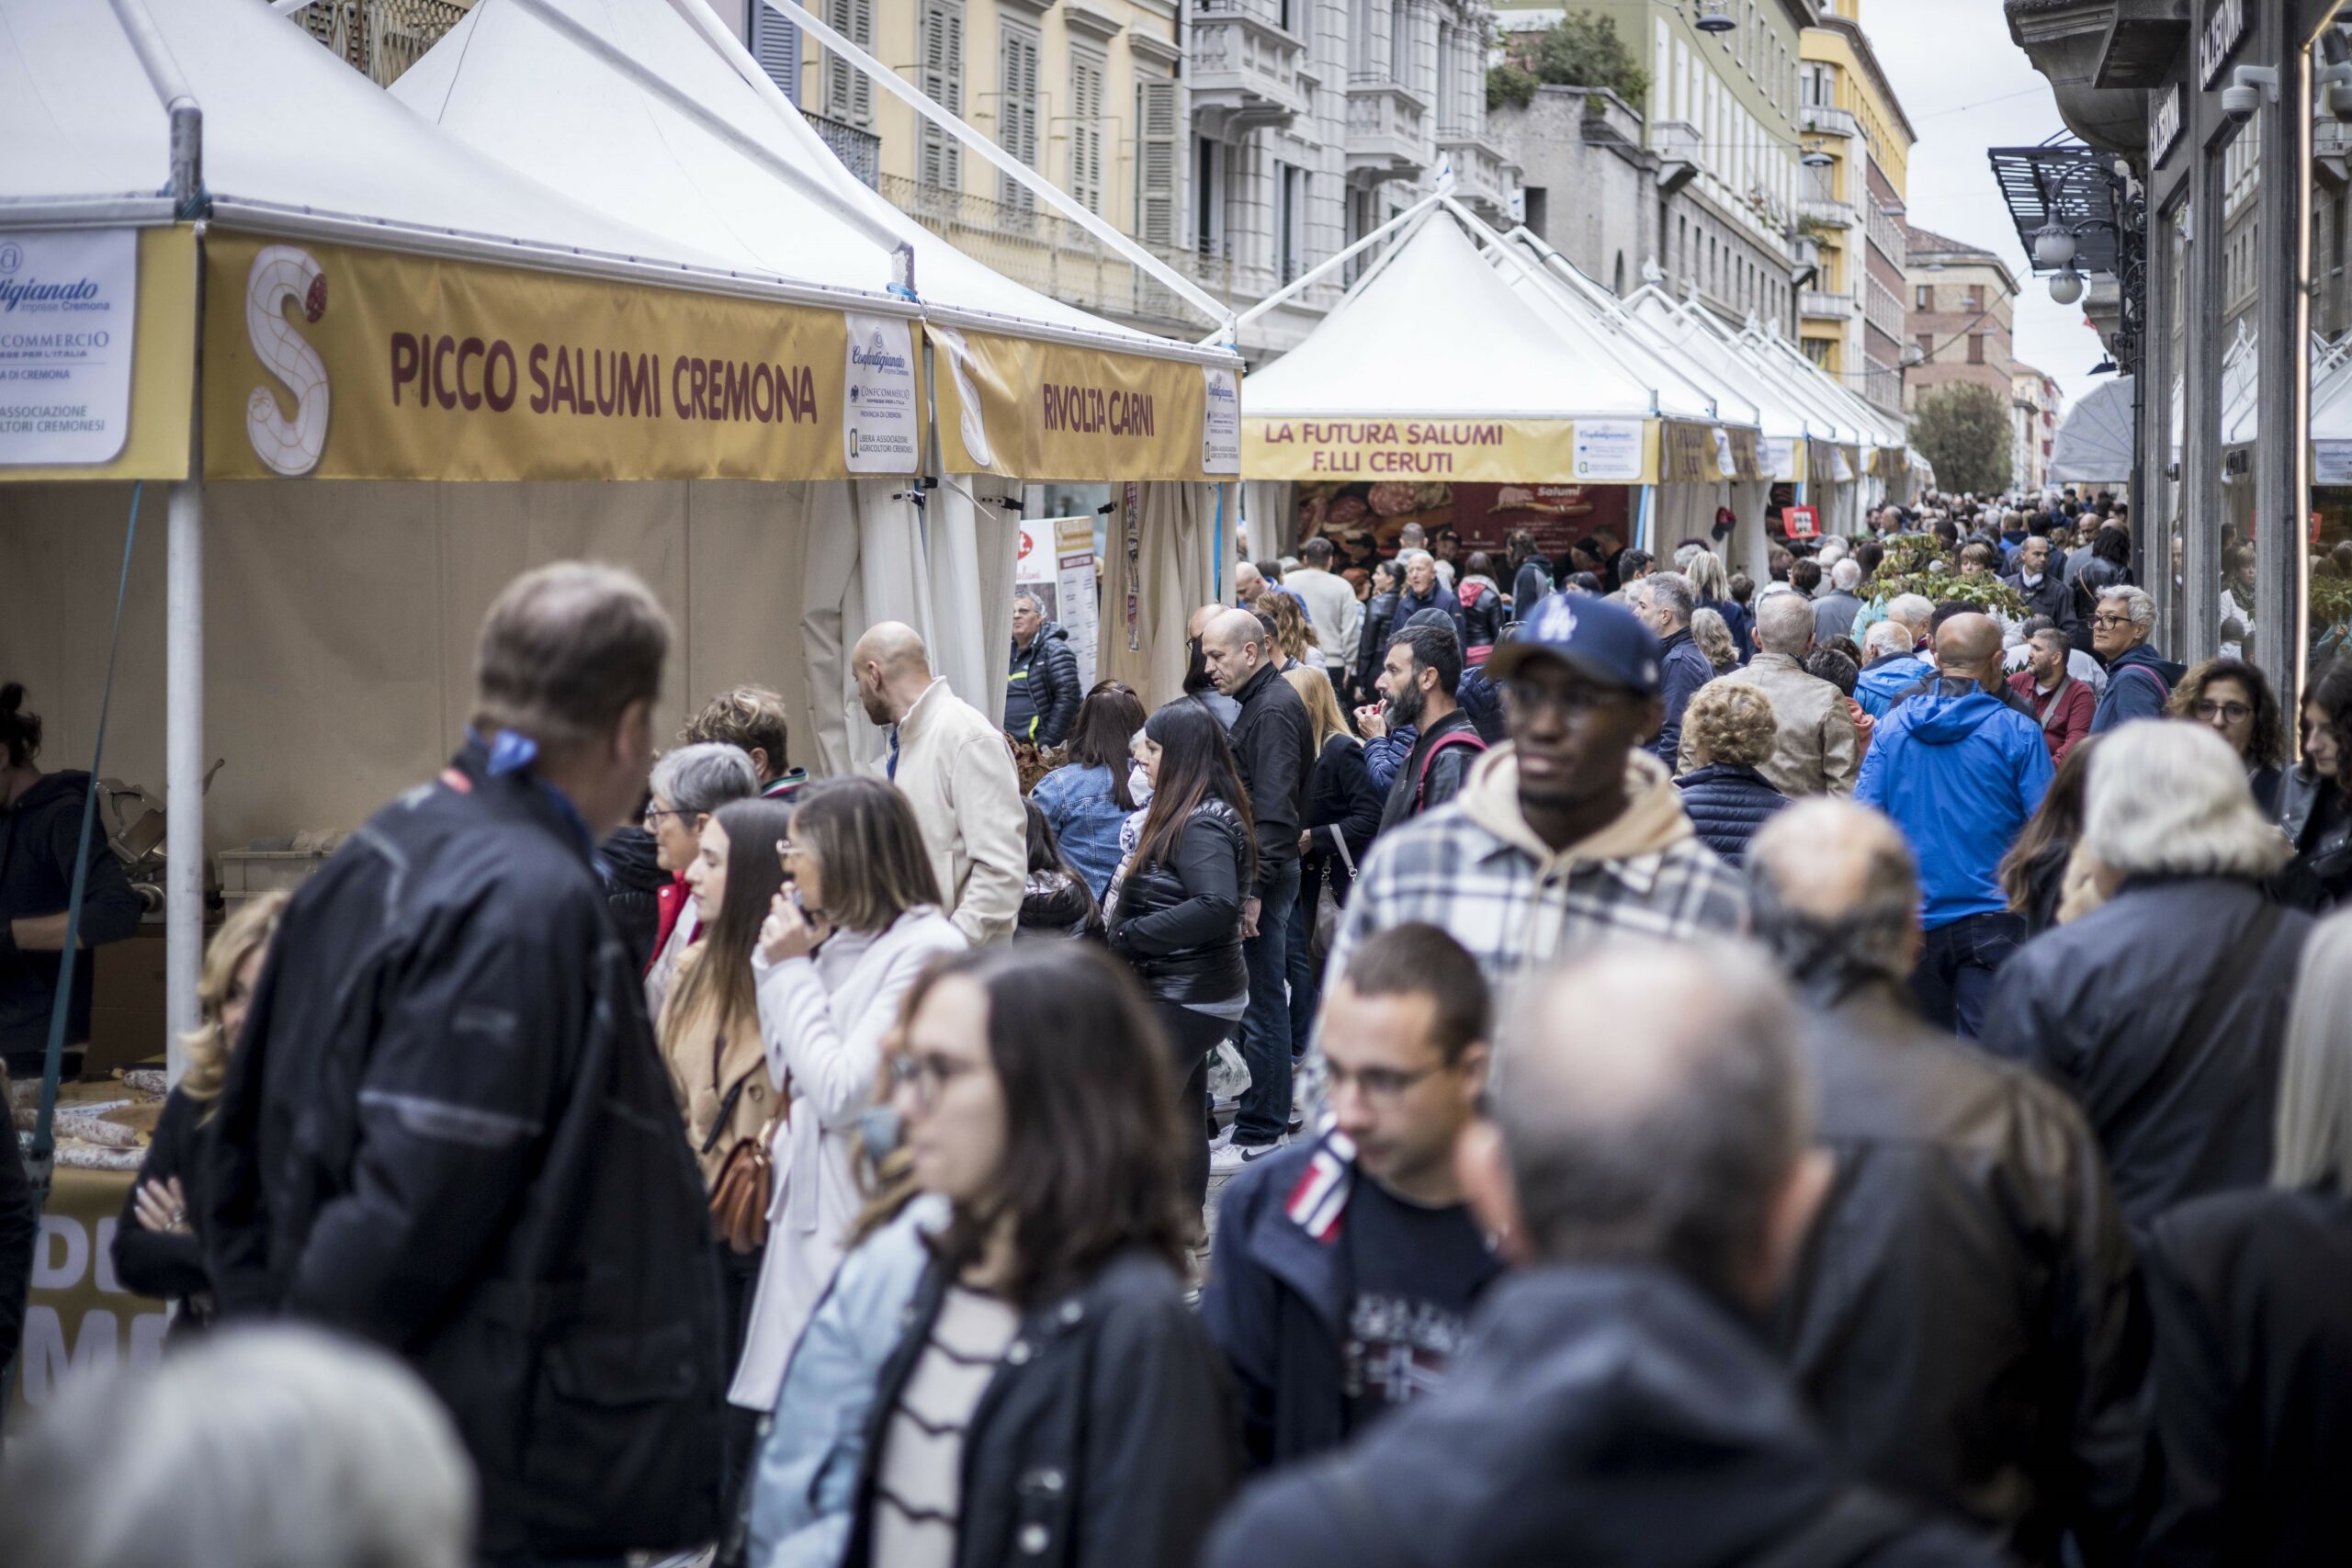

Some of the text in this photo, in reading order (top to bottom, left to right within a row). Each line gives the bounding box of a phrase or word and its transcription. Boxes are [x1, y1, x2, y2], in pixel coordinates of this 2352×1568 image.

[62, 300, 110, 311] Cremona
[44, 350, 87, 358] L'ITALIA
[8, 370, 19, 380] DI
[21, 370, 70, 380] CREMONA
[390, 332, 818, 425] PICCO SALUMI CREMONA
[1044, 383, 1106, 434] RIVOLTA
[1109, 390, 1154, 437] CARNI
[36, 420, 105, 433] CREMONESI
[859, 434, 909, 444] LIBERA ASSOCIAZIONE
[1265, 423, 1502, 446] LA FUTURA SALUMI
[859, 445, 892, 453] AGRICOLTORI
[1313, 451, 1453, 473] F.LLI CERUTI
[1537, 486, 1581, 497] Salumi
